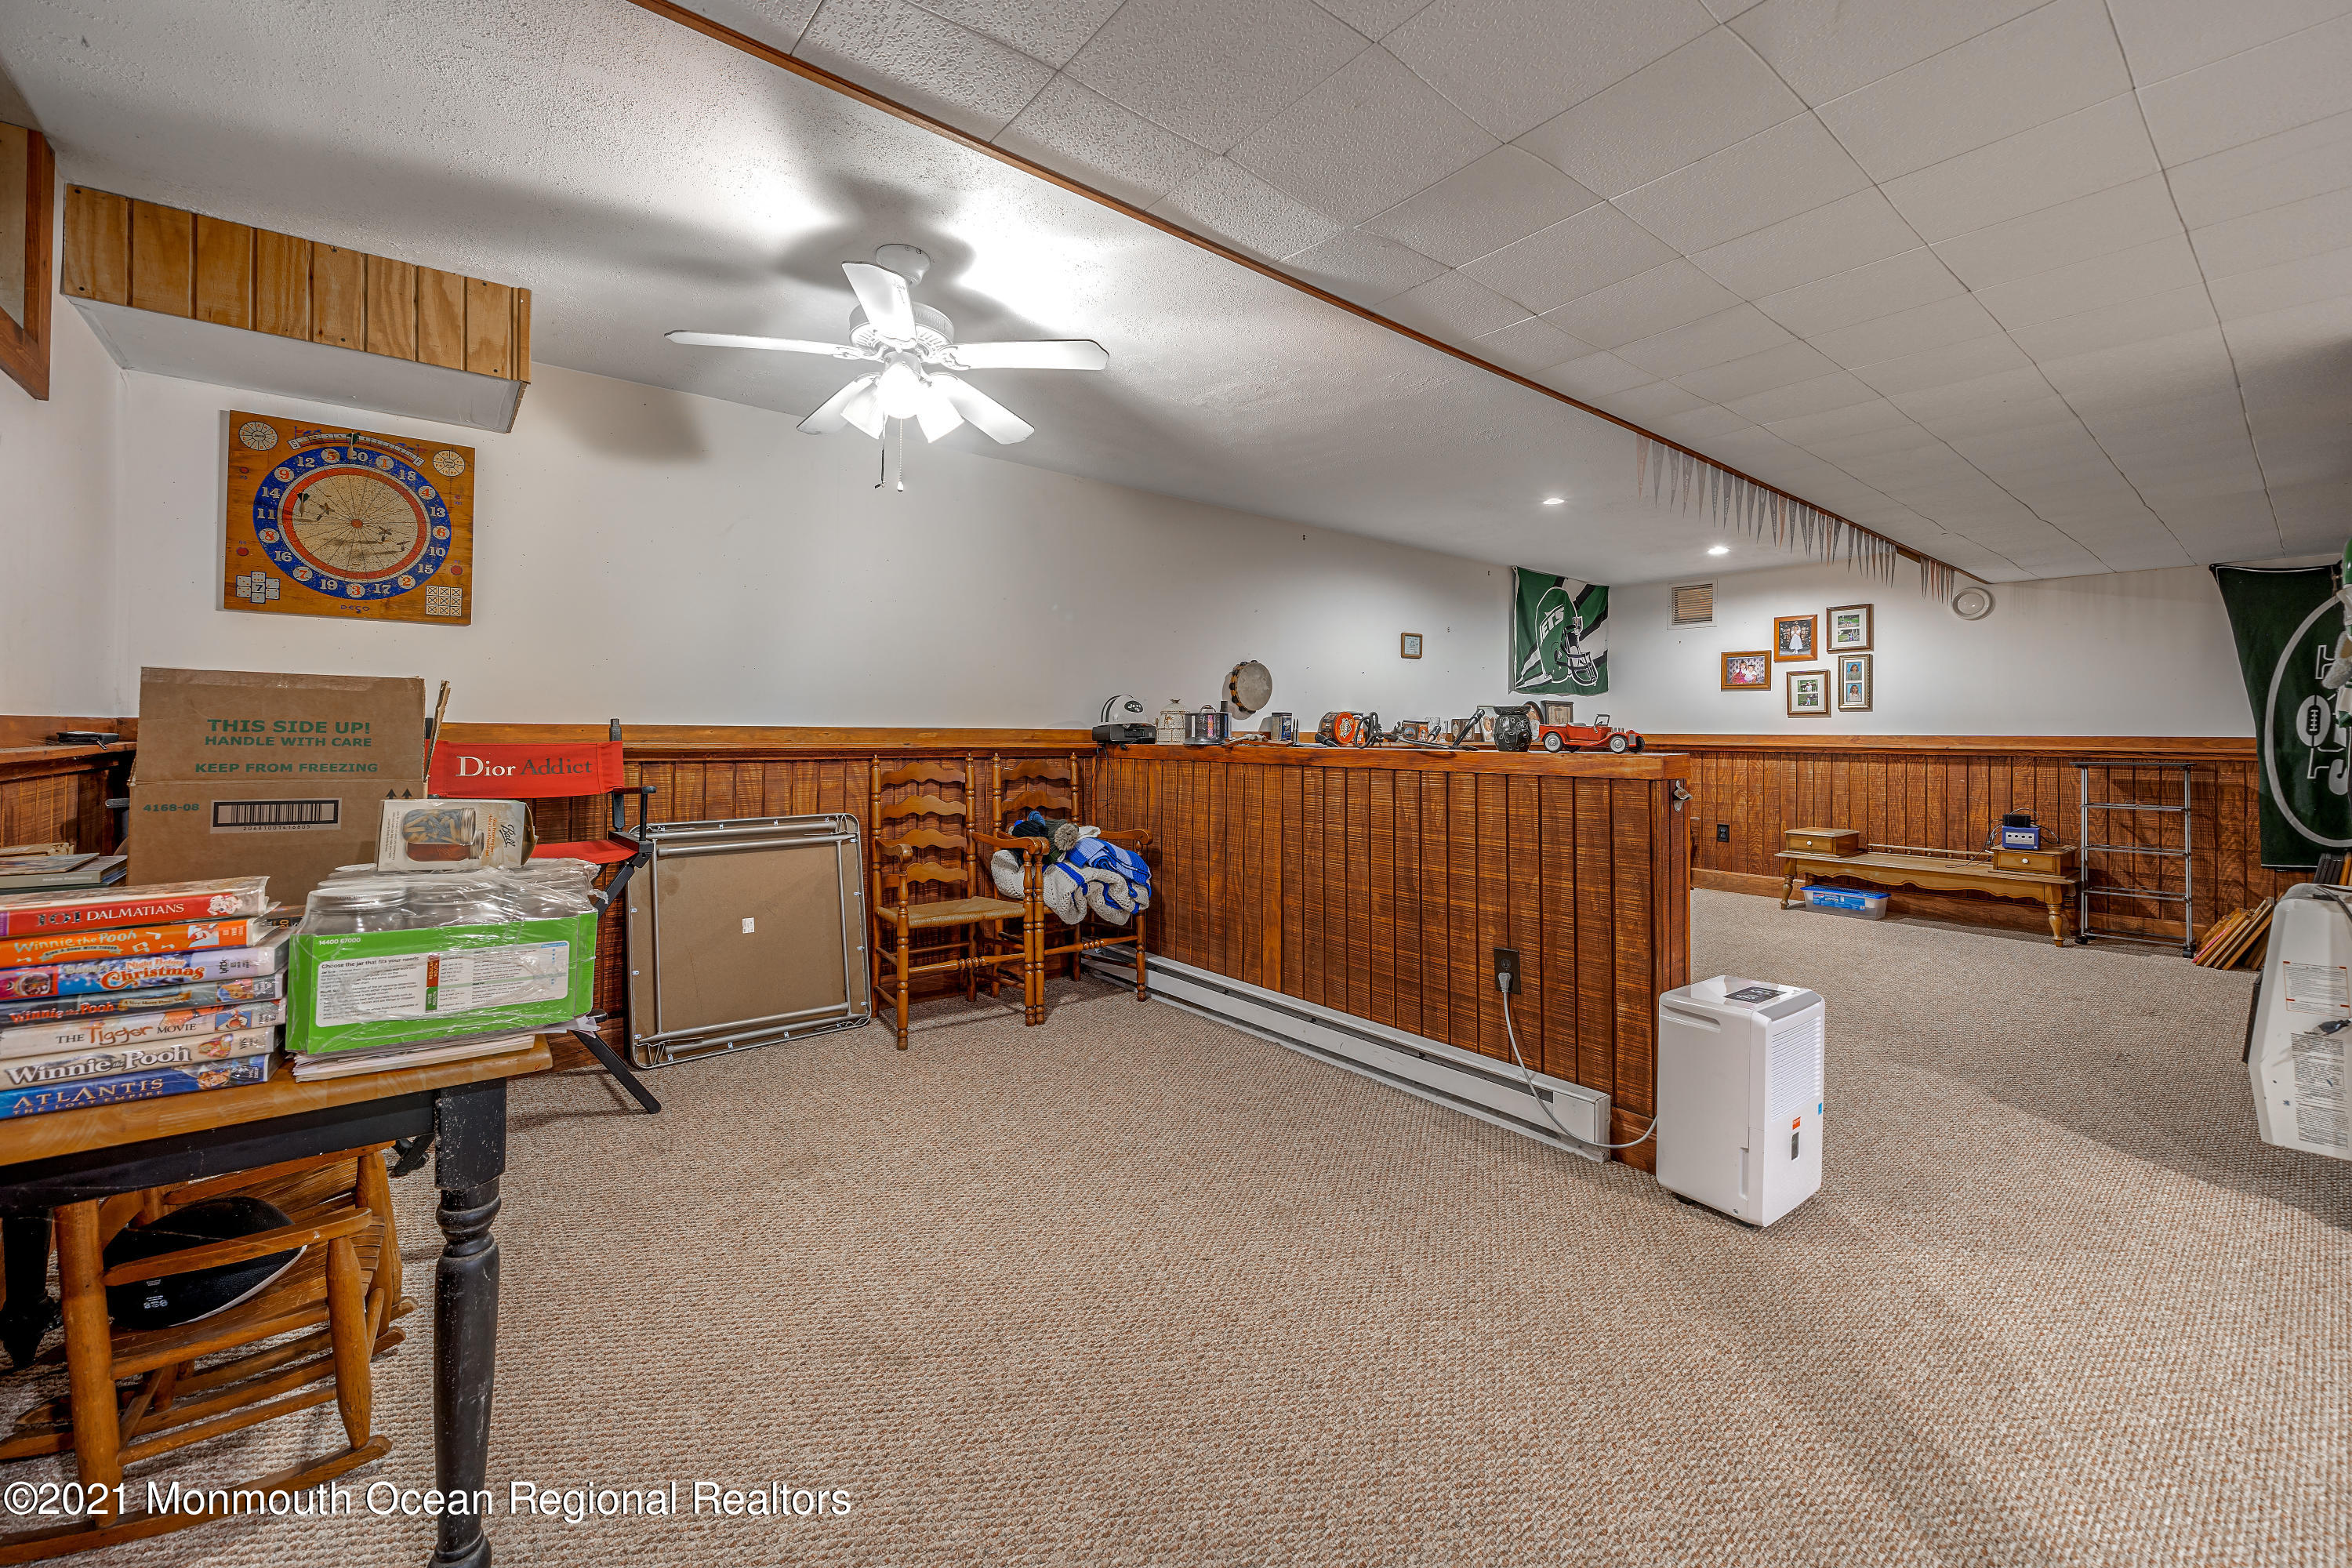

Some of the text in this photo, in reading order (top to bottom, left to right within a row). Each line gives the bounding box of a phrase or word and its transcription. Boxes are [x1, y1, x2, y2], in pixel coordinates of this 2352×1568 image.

[297, 456, 315, 468] 12
[326, 451, 336, 461] 5
[382, 459, 387, 468] 1
[279, 469, 290, 480] 9
[399, 469, 416, 481] 18
[261, 486, 281, 499] 14
[421, 488, 431, 497] 4
[256, 507, 276, 520] 11
[430, 506, 446, 517] 13
[264, 530, 274, 541] 8
[436, 528, 446, 538] 6
[274, 550, 292, 562] 16
[429, 546, 446, 557] 10
[299, 569, 308, 579] 7
[417, 564, 434, 575] 15
[319, 579, 338, 590] 19
[402, 576, 412, 586] 2
[351, 585, 361, 596] 3
[374, 583, 391, 594] 17
[207, 718, 371, 735] THIS SIDE UP!
[204, 735, 372, 747] HANDLE WITH CARE
[195, 763, 379, 773] KEEP FROM FREEZING
[455, 755, 593, 777] Dior Addict
[143, 803, 200, 812] 4168-08
[499, 824, 516, 848] Ball
[37, 903, 185, 927] 101 DALMATIANS
[14, 930, 137, 953] Winnie the Pooh
[125, 957, 187, 970] Night Before
[100, 967, 206, 989] Christmas
[9, 1007, 64, 1025] Winnie
[79, 1001, 114, 1014] Pooh
[56, 1023, 197, 1046] THE Tigger MOVIE
[6, 1058, 114, 1085] Winnie
[122, 1045, 193, 1071] Pooh
[13, 1078, 165, 1110] ATLANTIS
[13, 1090, 164, 1116] THE LOST EMPIRE
